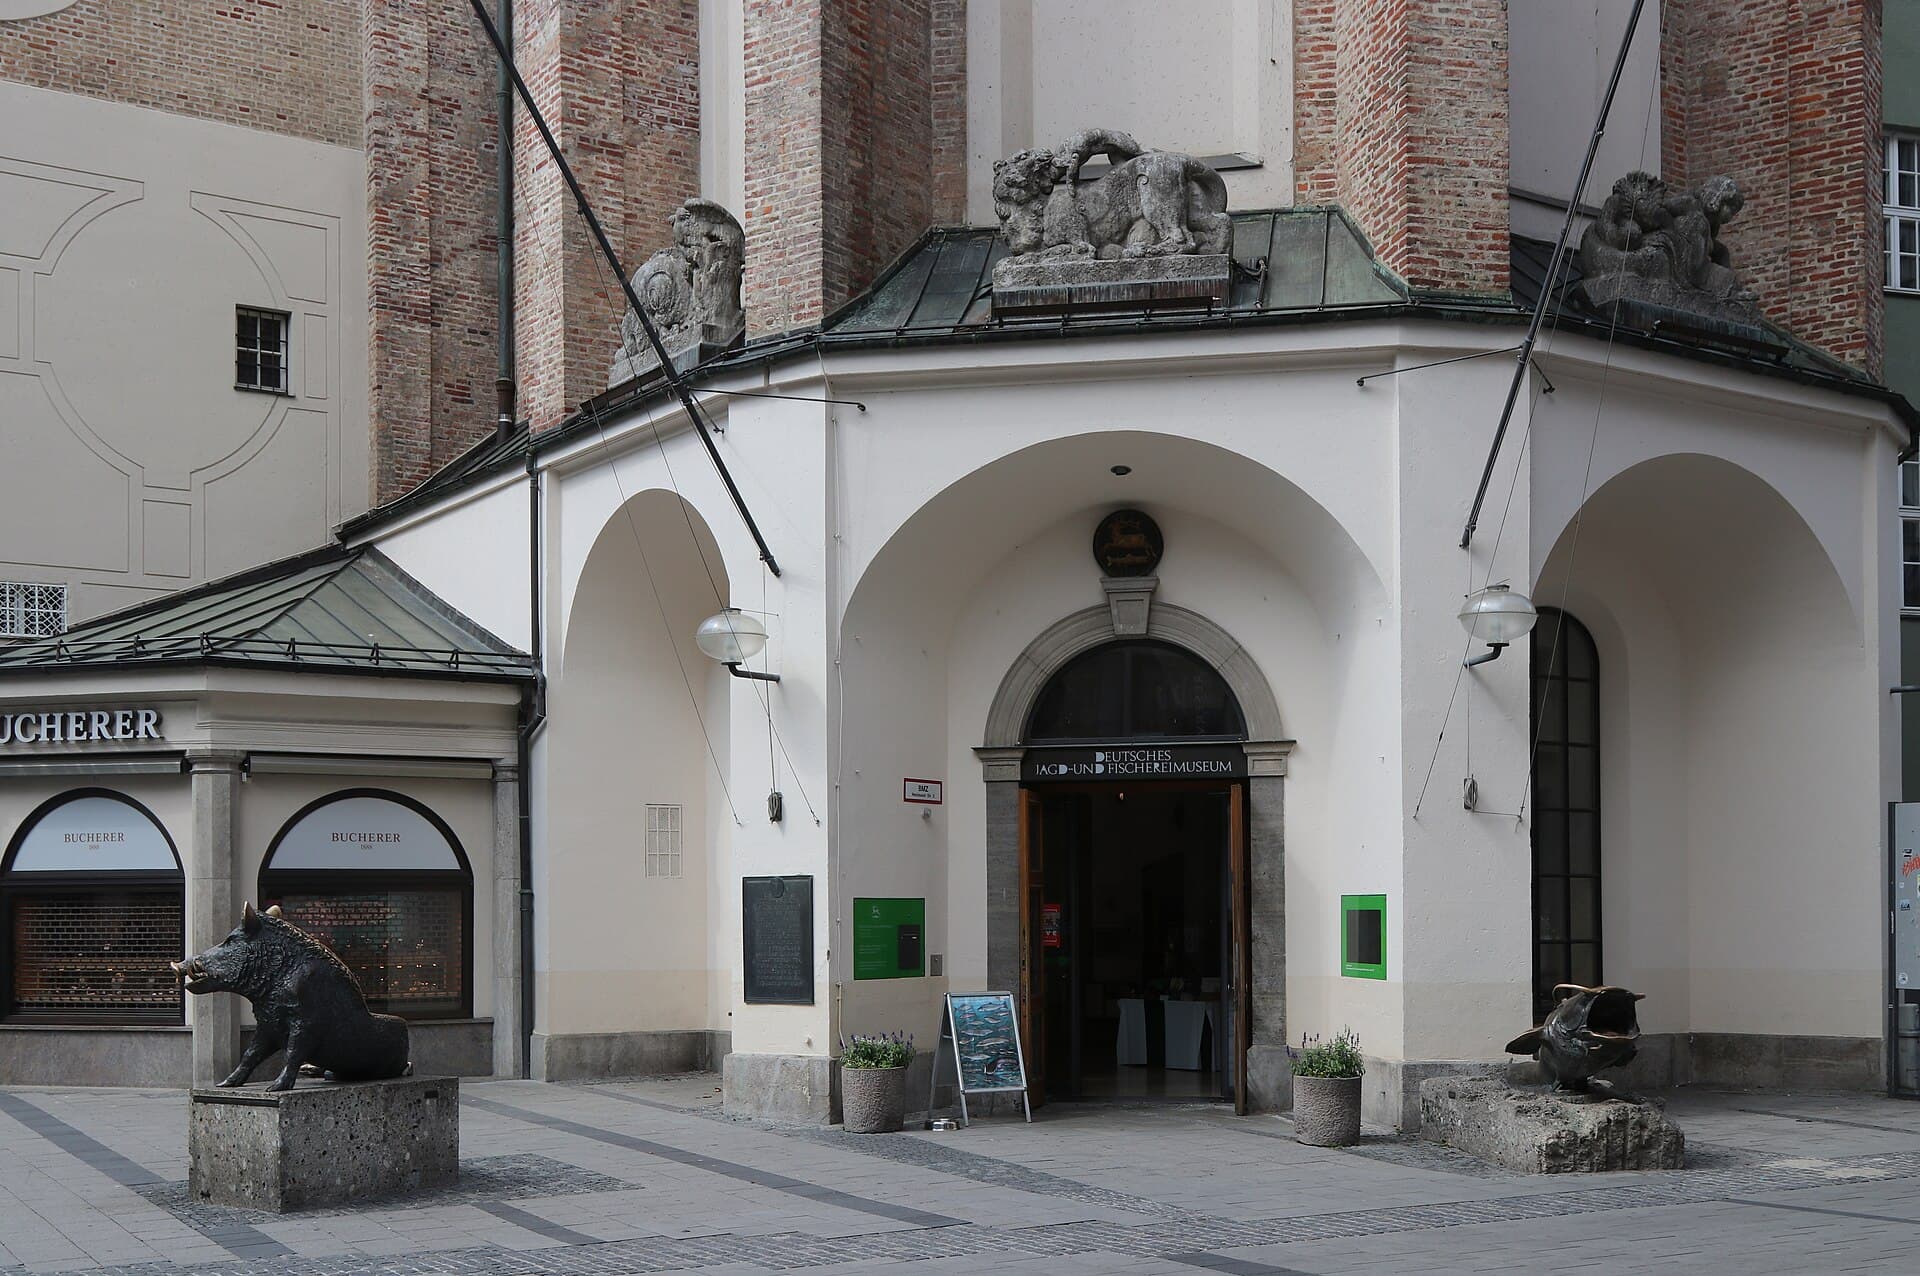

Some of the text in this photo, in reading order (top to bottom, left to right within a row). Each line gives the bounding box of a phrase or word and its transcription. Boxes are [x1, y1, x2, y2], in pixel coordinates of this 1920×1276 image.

[1095, 750, 1171, 763] DEUTSCHES
[1036, 760, 1232, 775] JAGD-UND FISCHEREIMUSEUM
[64, 832, 125, 843] BUCHERER
[331, 832, 401, 843] BUCHERER
